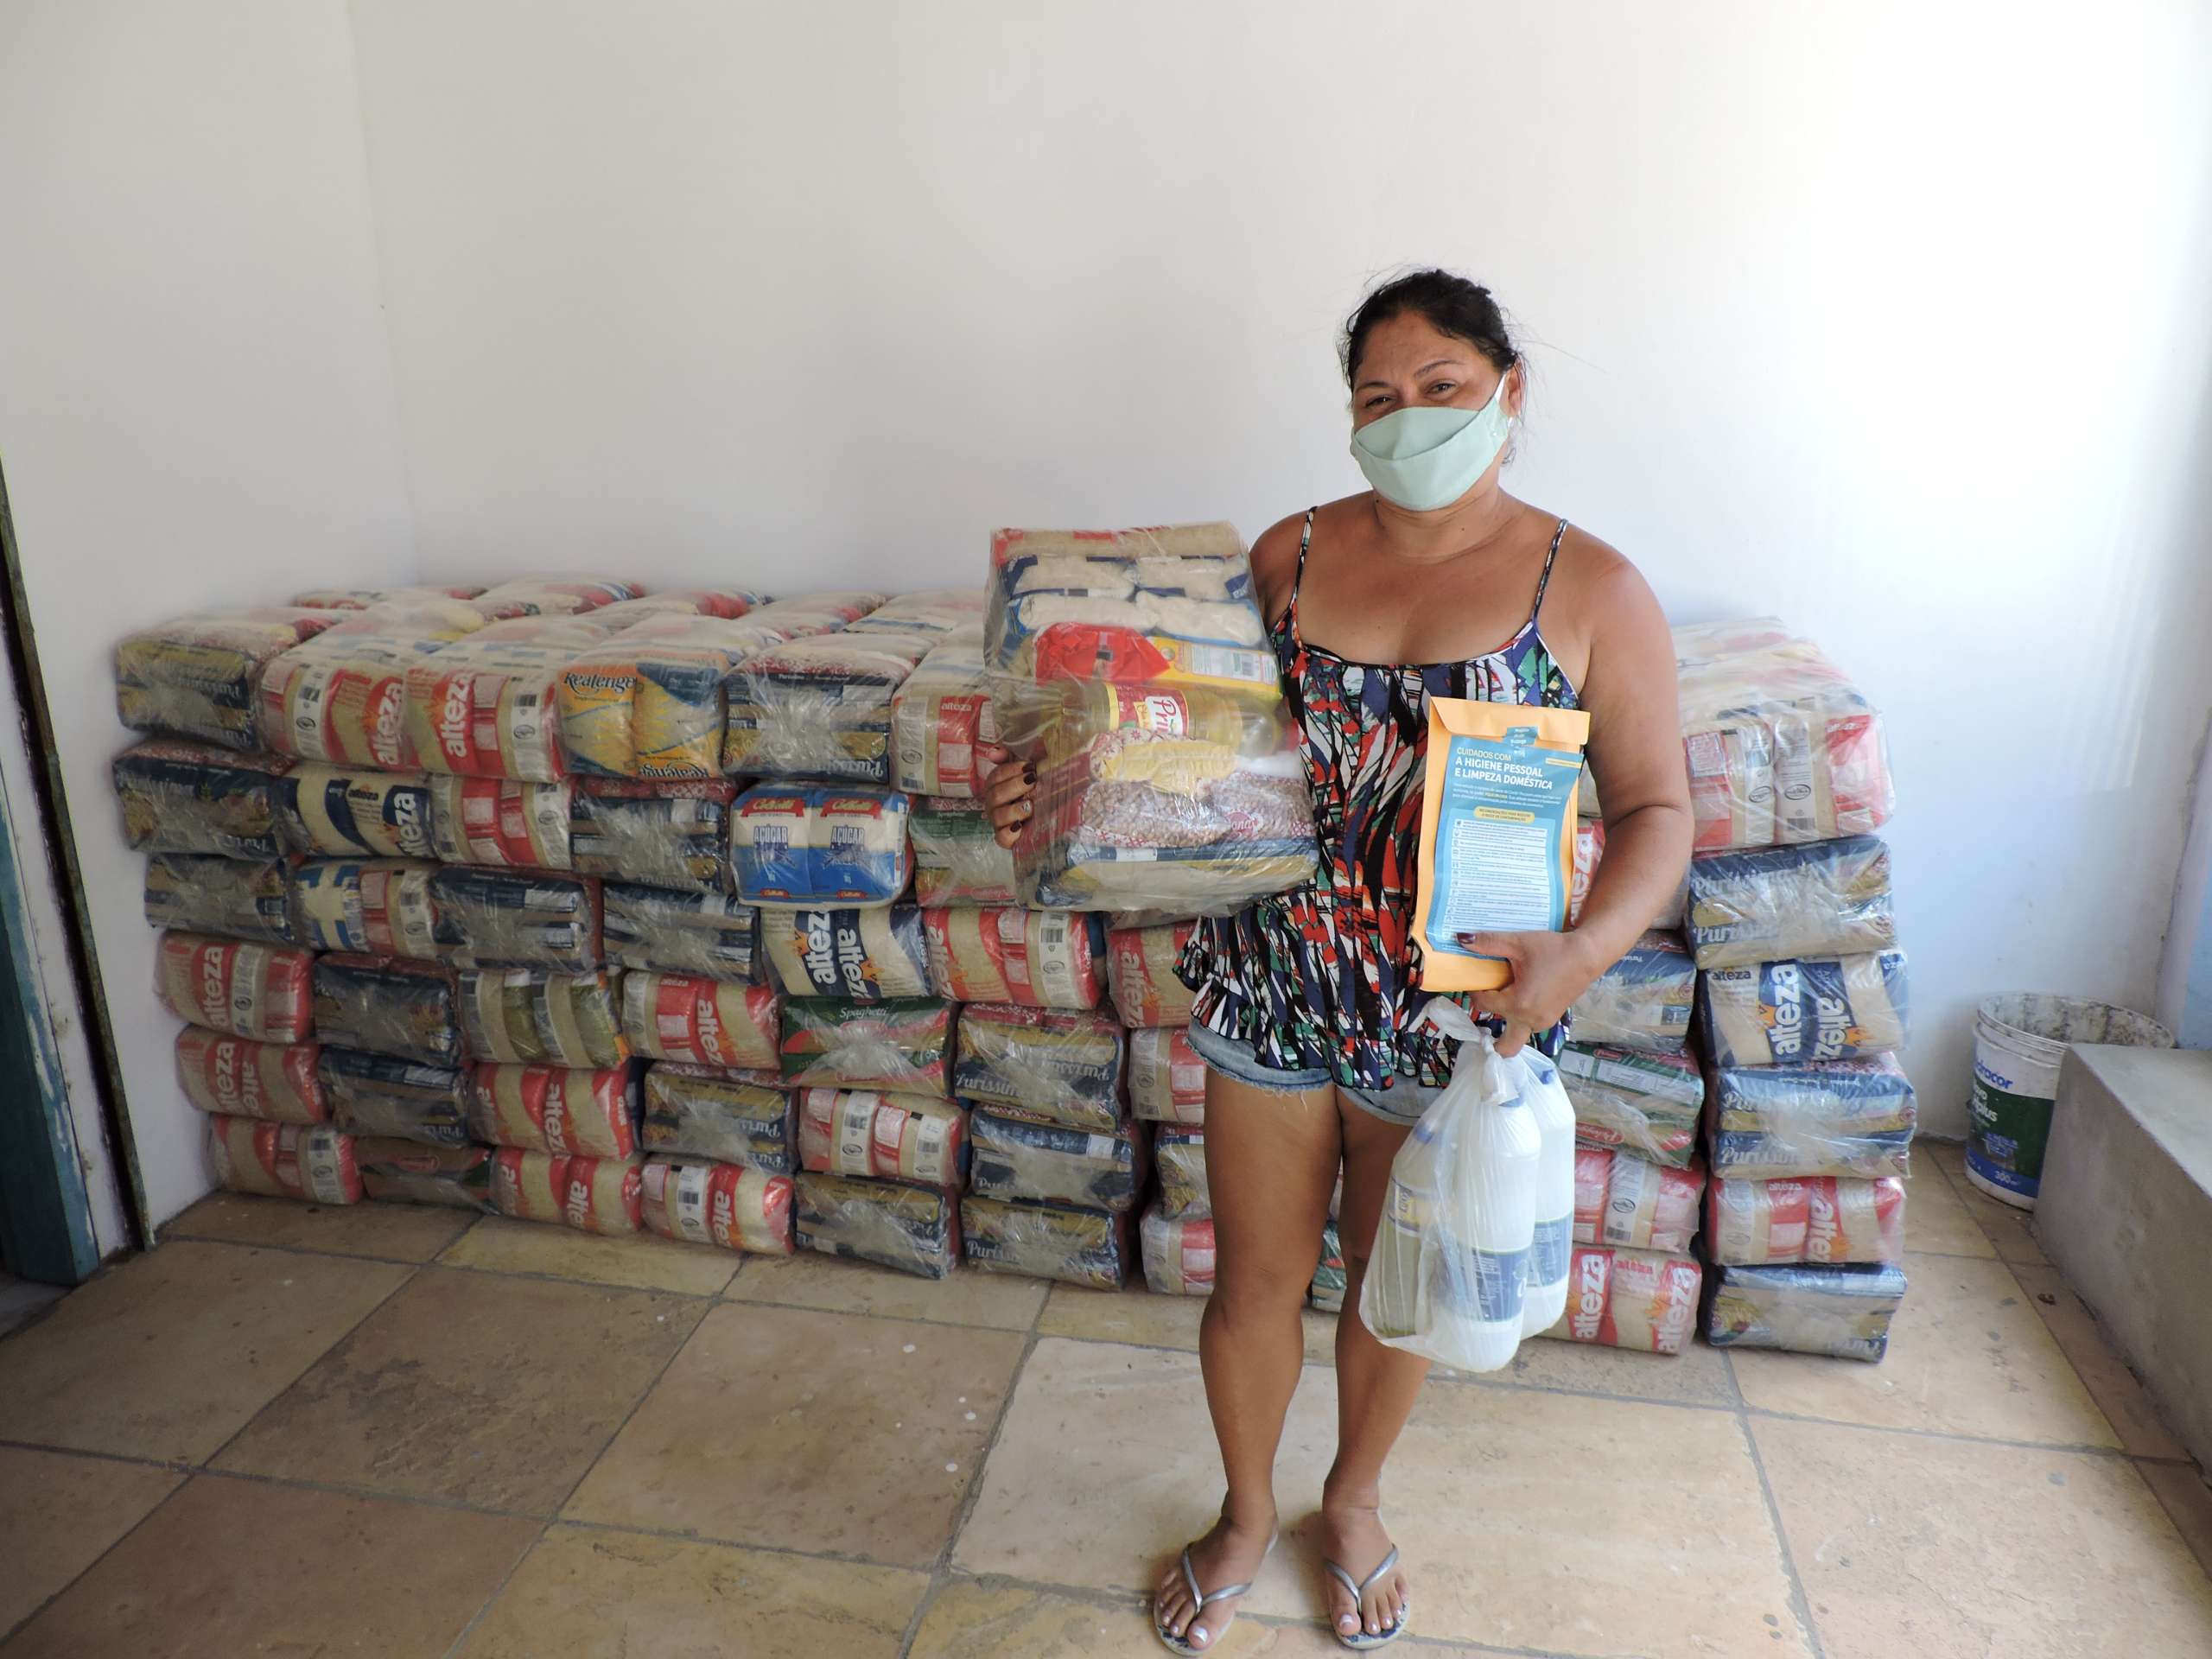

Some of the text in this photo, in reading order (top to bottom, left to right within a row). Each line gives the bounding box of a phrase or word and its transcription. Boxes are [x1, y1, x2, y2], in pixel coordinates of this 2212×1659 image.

[441, 672, 471, 758] alteza
[942, 702, 972, 711] alteza
[1454, 767, 1461, 778] E
[1463, 769, 1502, 783] LIMPEZA
[1455, 756, 1543, 778] A HIGIENE PESSOAL
[1457, 747, 1493, 760] CUIDADOS
[753, 823, 788, 846] AÇÚCAR
[830, 825, 865, 846] AÇÚCAR
[805, 910, 838, 985] altez
[837, 927, 873, 1000] altez
[1711, 969, 1752, 982] alteza
[203, 945, 229, 1029] alteza
[839, 1006, 889, 1019] Spaghetti
[1770, 963, 1802, 1056] alteza
[696, 998, 726, 1065] altez
[1813, 996, 1853, 1060] altez
[545, 1083, 571, 1158] altez
[566, 1179, 589, 1226] alte
[714, 1190, 734, 1247] alte
[1809, 1196, 1839, 1262] alte
[1573, 1254, 1605, 1338] alteza
[1658, 1267, 1696, 1351] alteza
